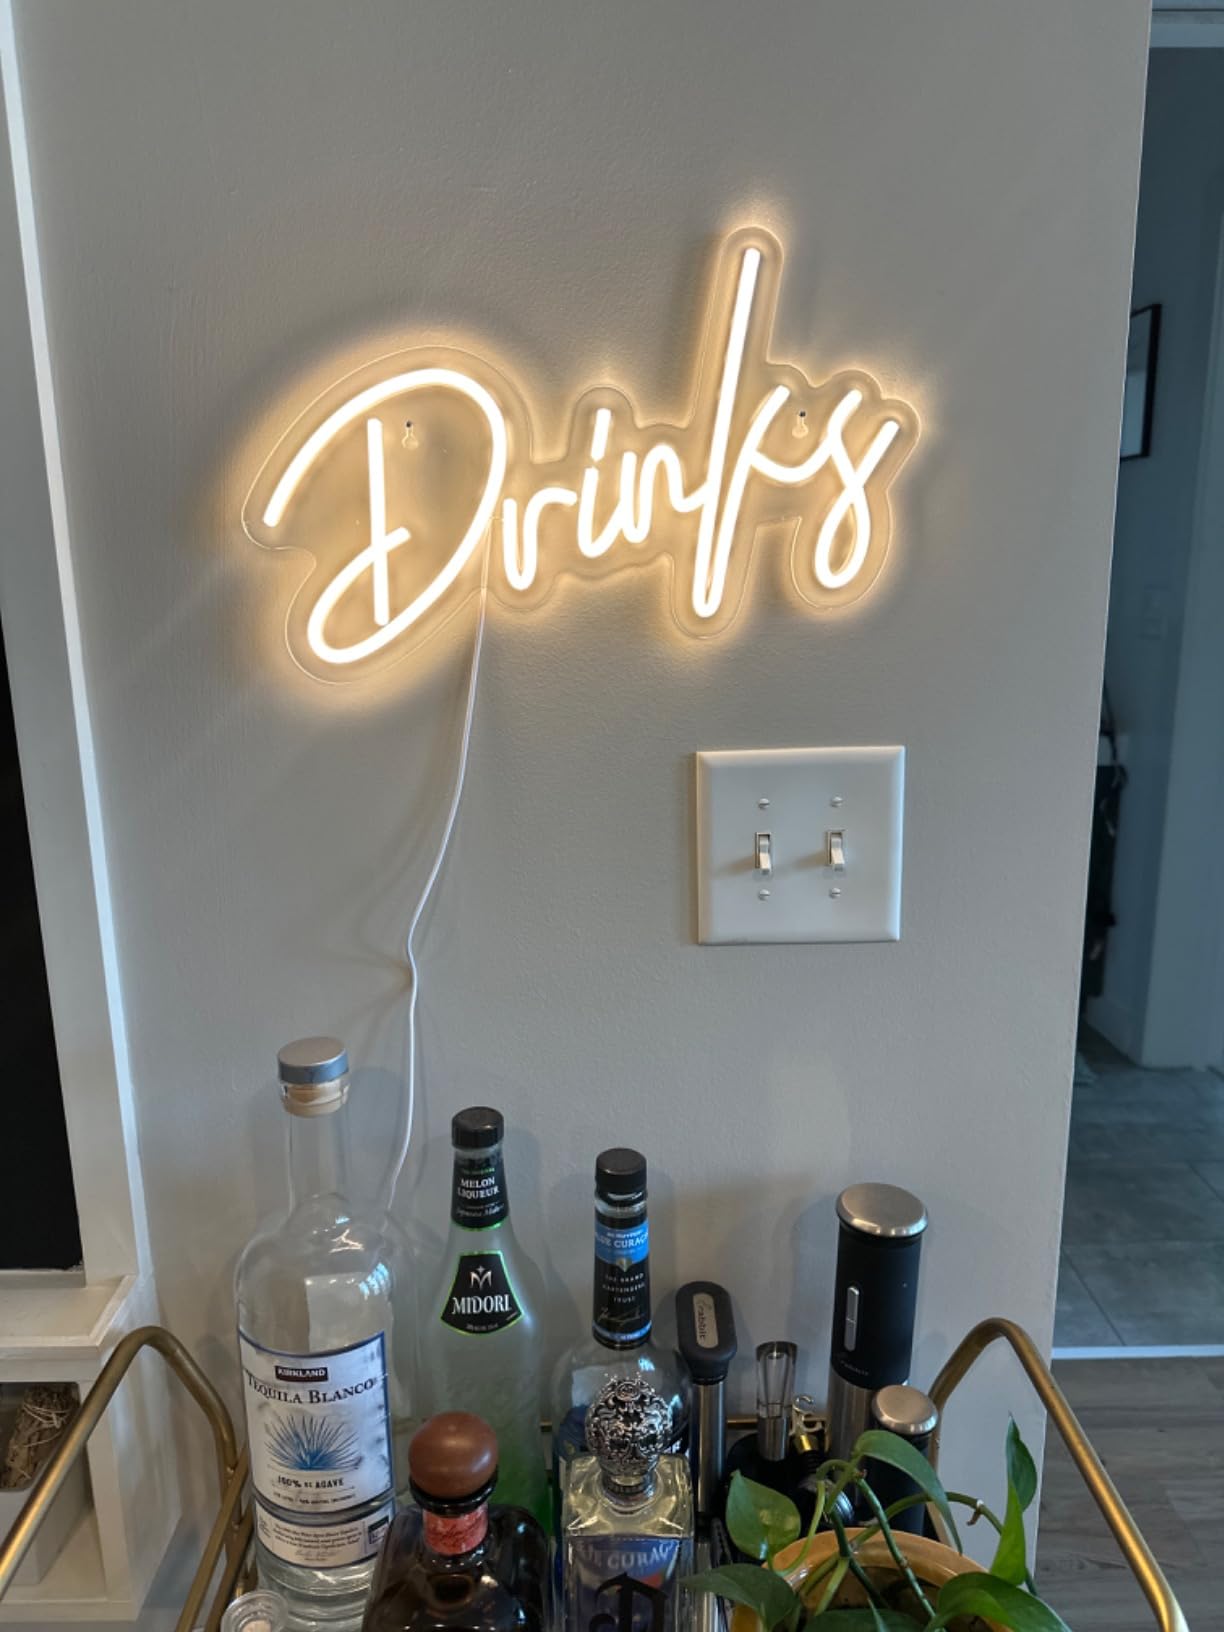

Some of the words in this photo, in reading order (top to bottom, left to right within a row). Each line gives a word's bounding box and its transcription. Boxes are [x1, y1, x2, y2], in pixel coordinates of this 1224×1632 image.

[263, 248, 898, 664] Drinks
[461, 1176, 495, 1188] MELON
[457, 1185, 499, 1199] LIQUEUR
[452, 1294, 512, 1315] MIDORI
[277, 1368, 327, 1378] KIRKLAND
[246, 1374, 303, 1405] TEQUILA
[308, 1378, 374, 1404] BLANCO
[315, 1478, 344, 1489] AGAVE
